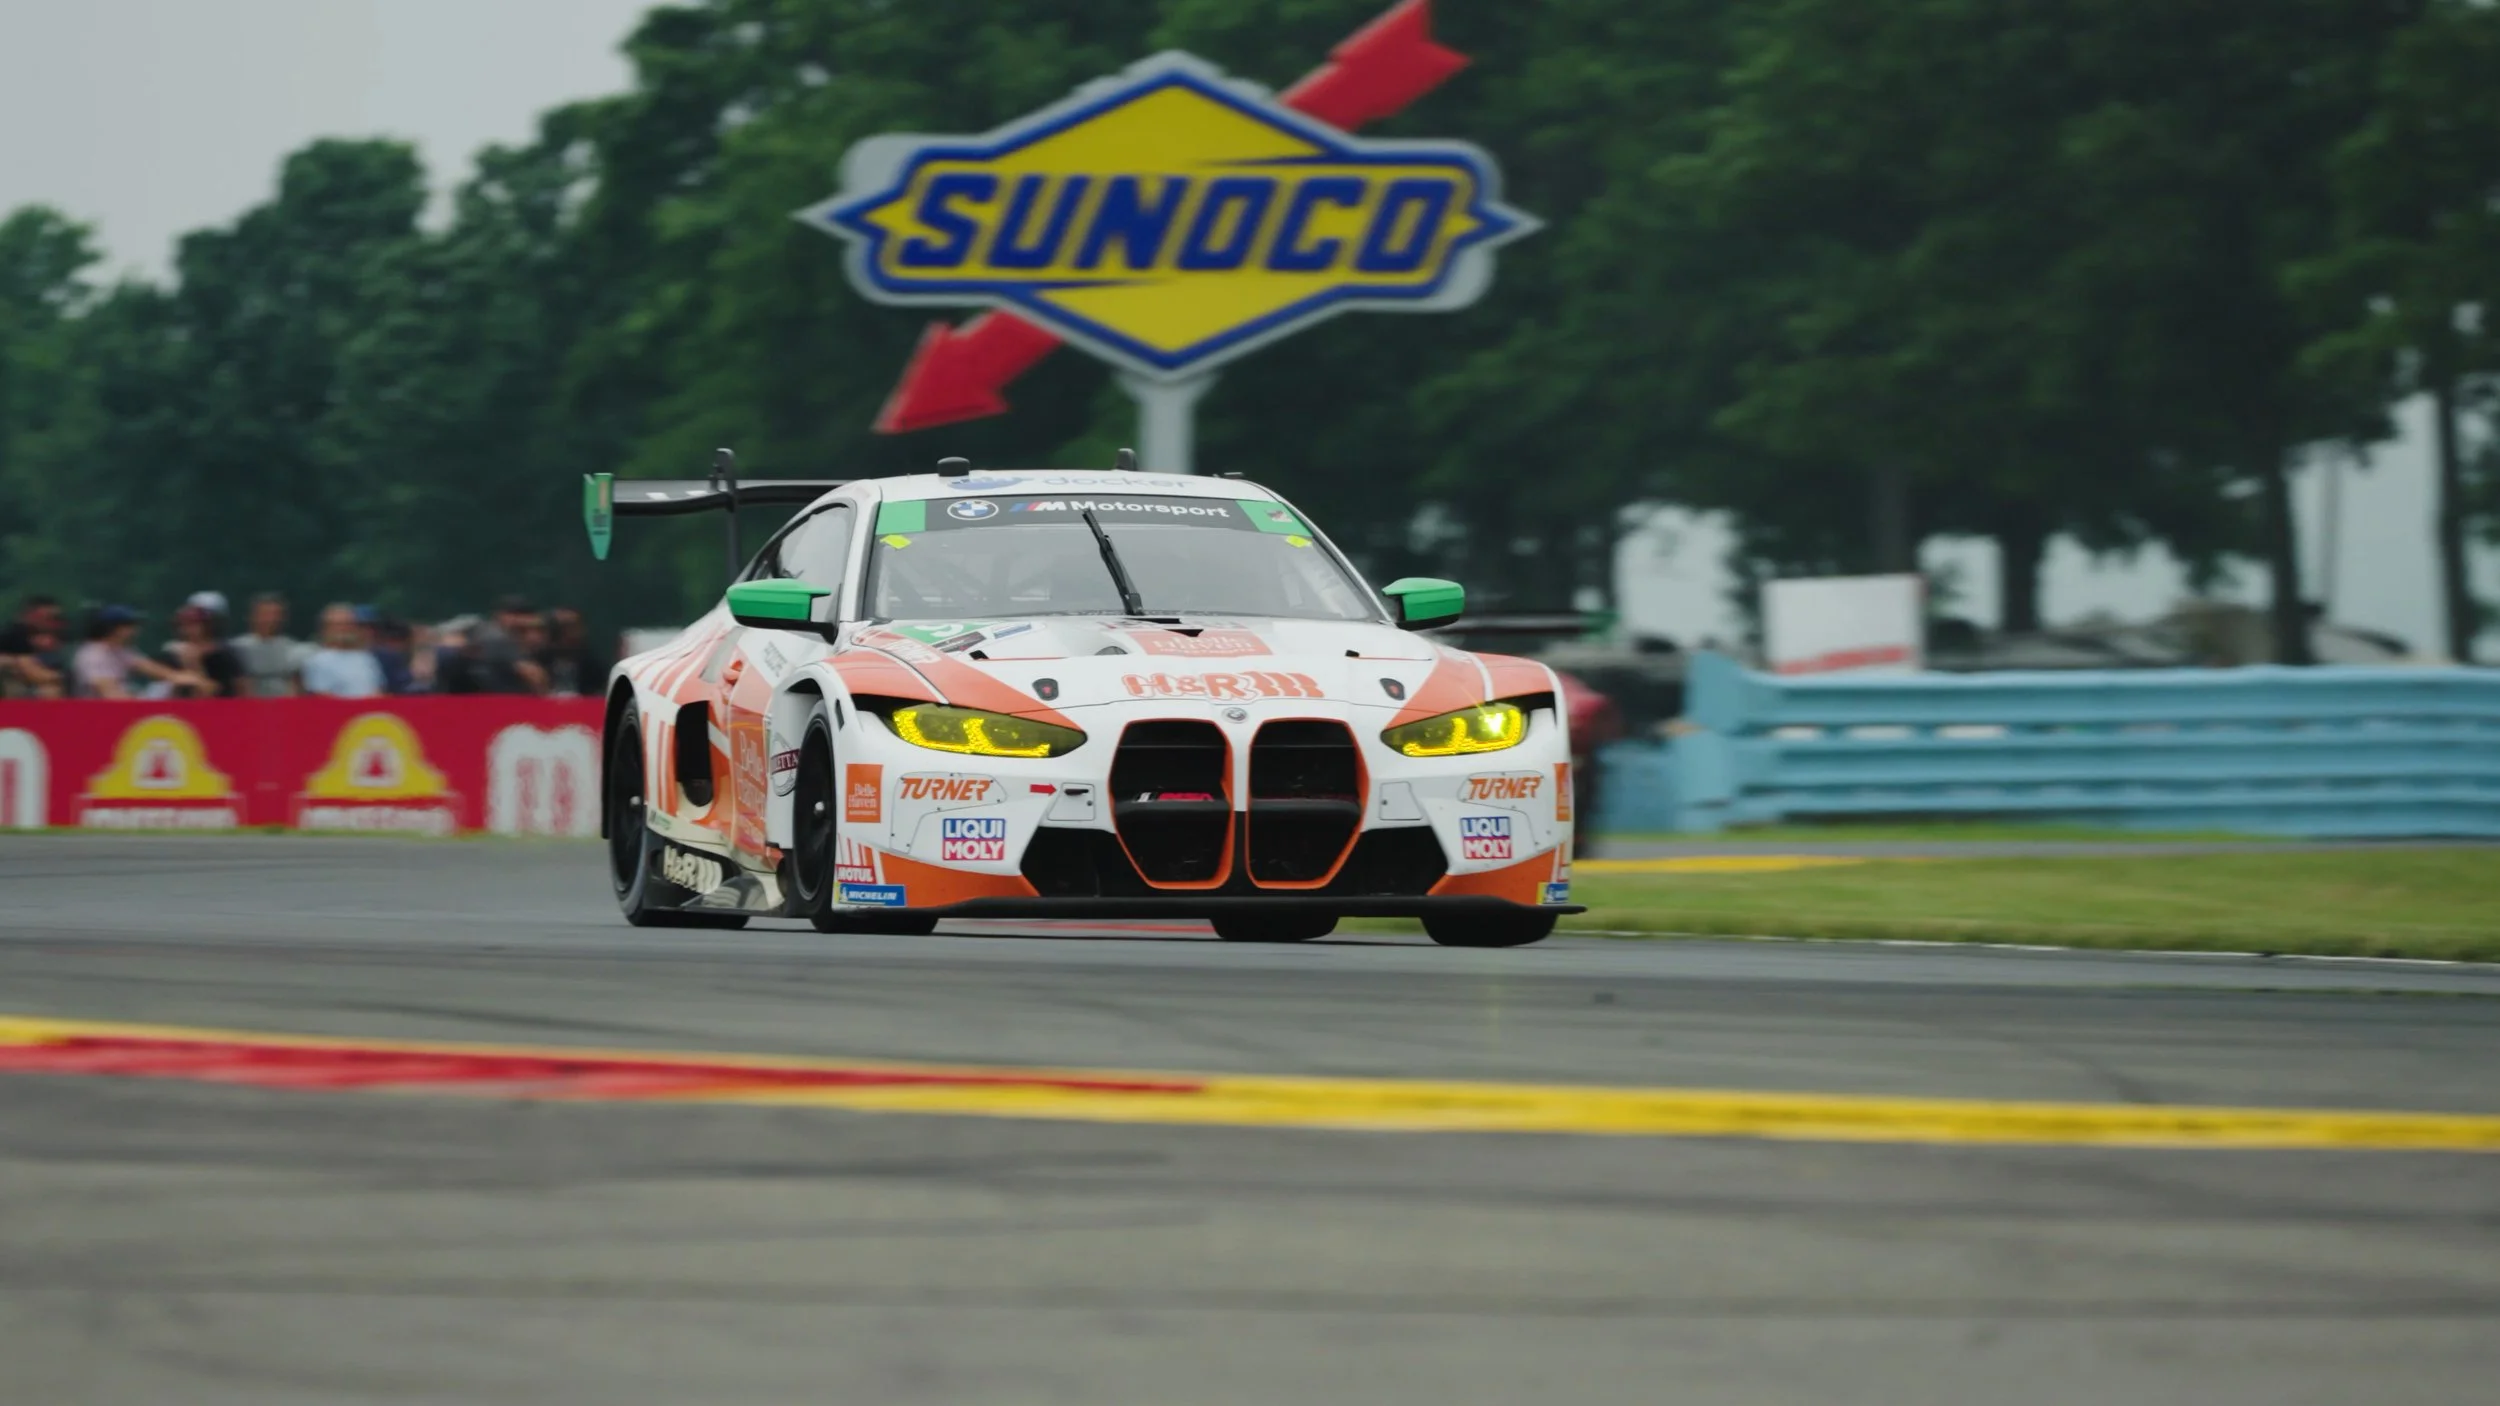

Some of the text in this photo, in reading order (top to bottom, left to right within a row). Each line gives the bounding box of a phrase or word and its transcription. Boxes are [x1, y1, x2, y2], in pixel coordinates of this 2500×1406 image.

[899, 172, 1456, 272] SUNOCO
[1043, 474, 1193, 488] docker
[1069, 501, 1230, 519] Motorsport
[900, 778, 991, 800] TURNER
[1469, 777, 1542, 799] TURNER
[944, 819, 1003, 838] LIQUI
[1461, 818, 1510, 836] LIQUI
[944, 841, 1003, 859] MOLY
[1465, 840, 1512, 858] MOLY
[837, 867, 874, 882] MOTUL
[849, 890, 898, 901] MICHELIN
